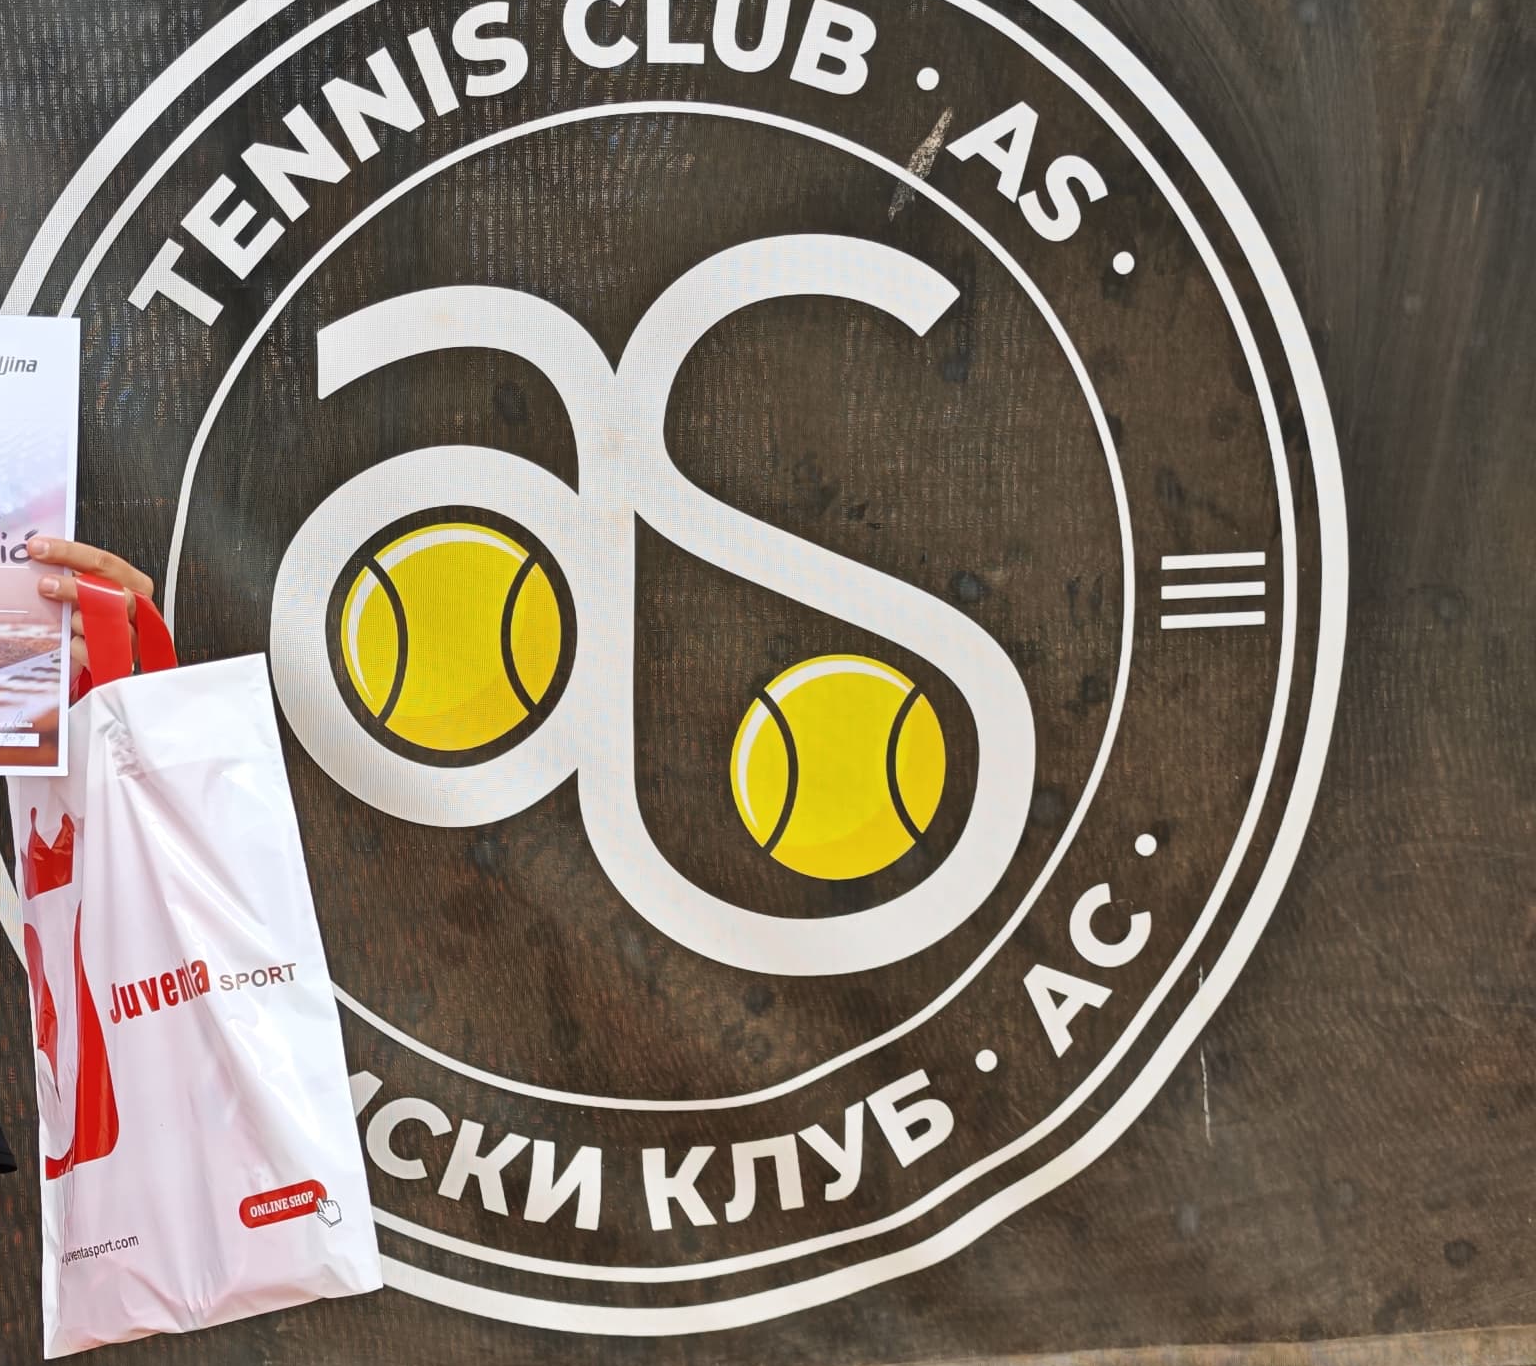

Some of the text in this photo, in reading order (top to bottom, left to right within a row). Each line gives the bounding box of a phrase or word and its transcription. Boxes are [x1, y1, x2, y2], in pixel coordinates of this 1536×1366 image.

[127, 0, 530, 327] TENNIS
[946, 101, 1108, 241] AS
[219, 962, 297, 991] SPORT
[348, 1068, 955, 1231] СКИ КЛУБ
[249, 1190, 314, 1218] ONLINE SHOP
